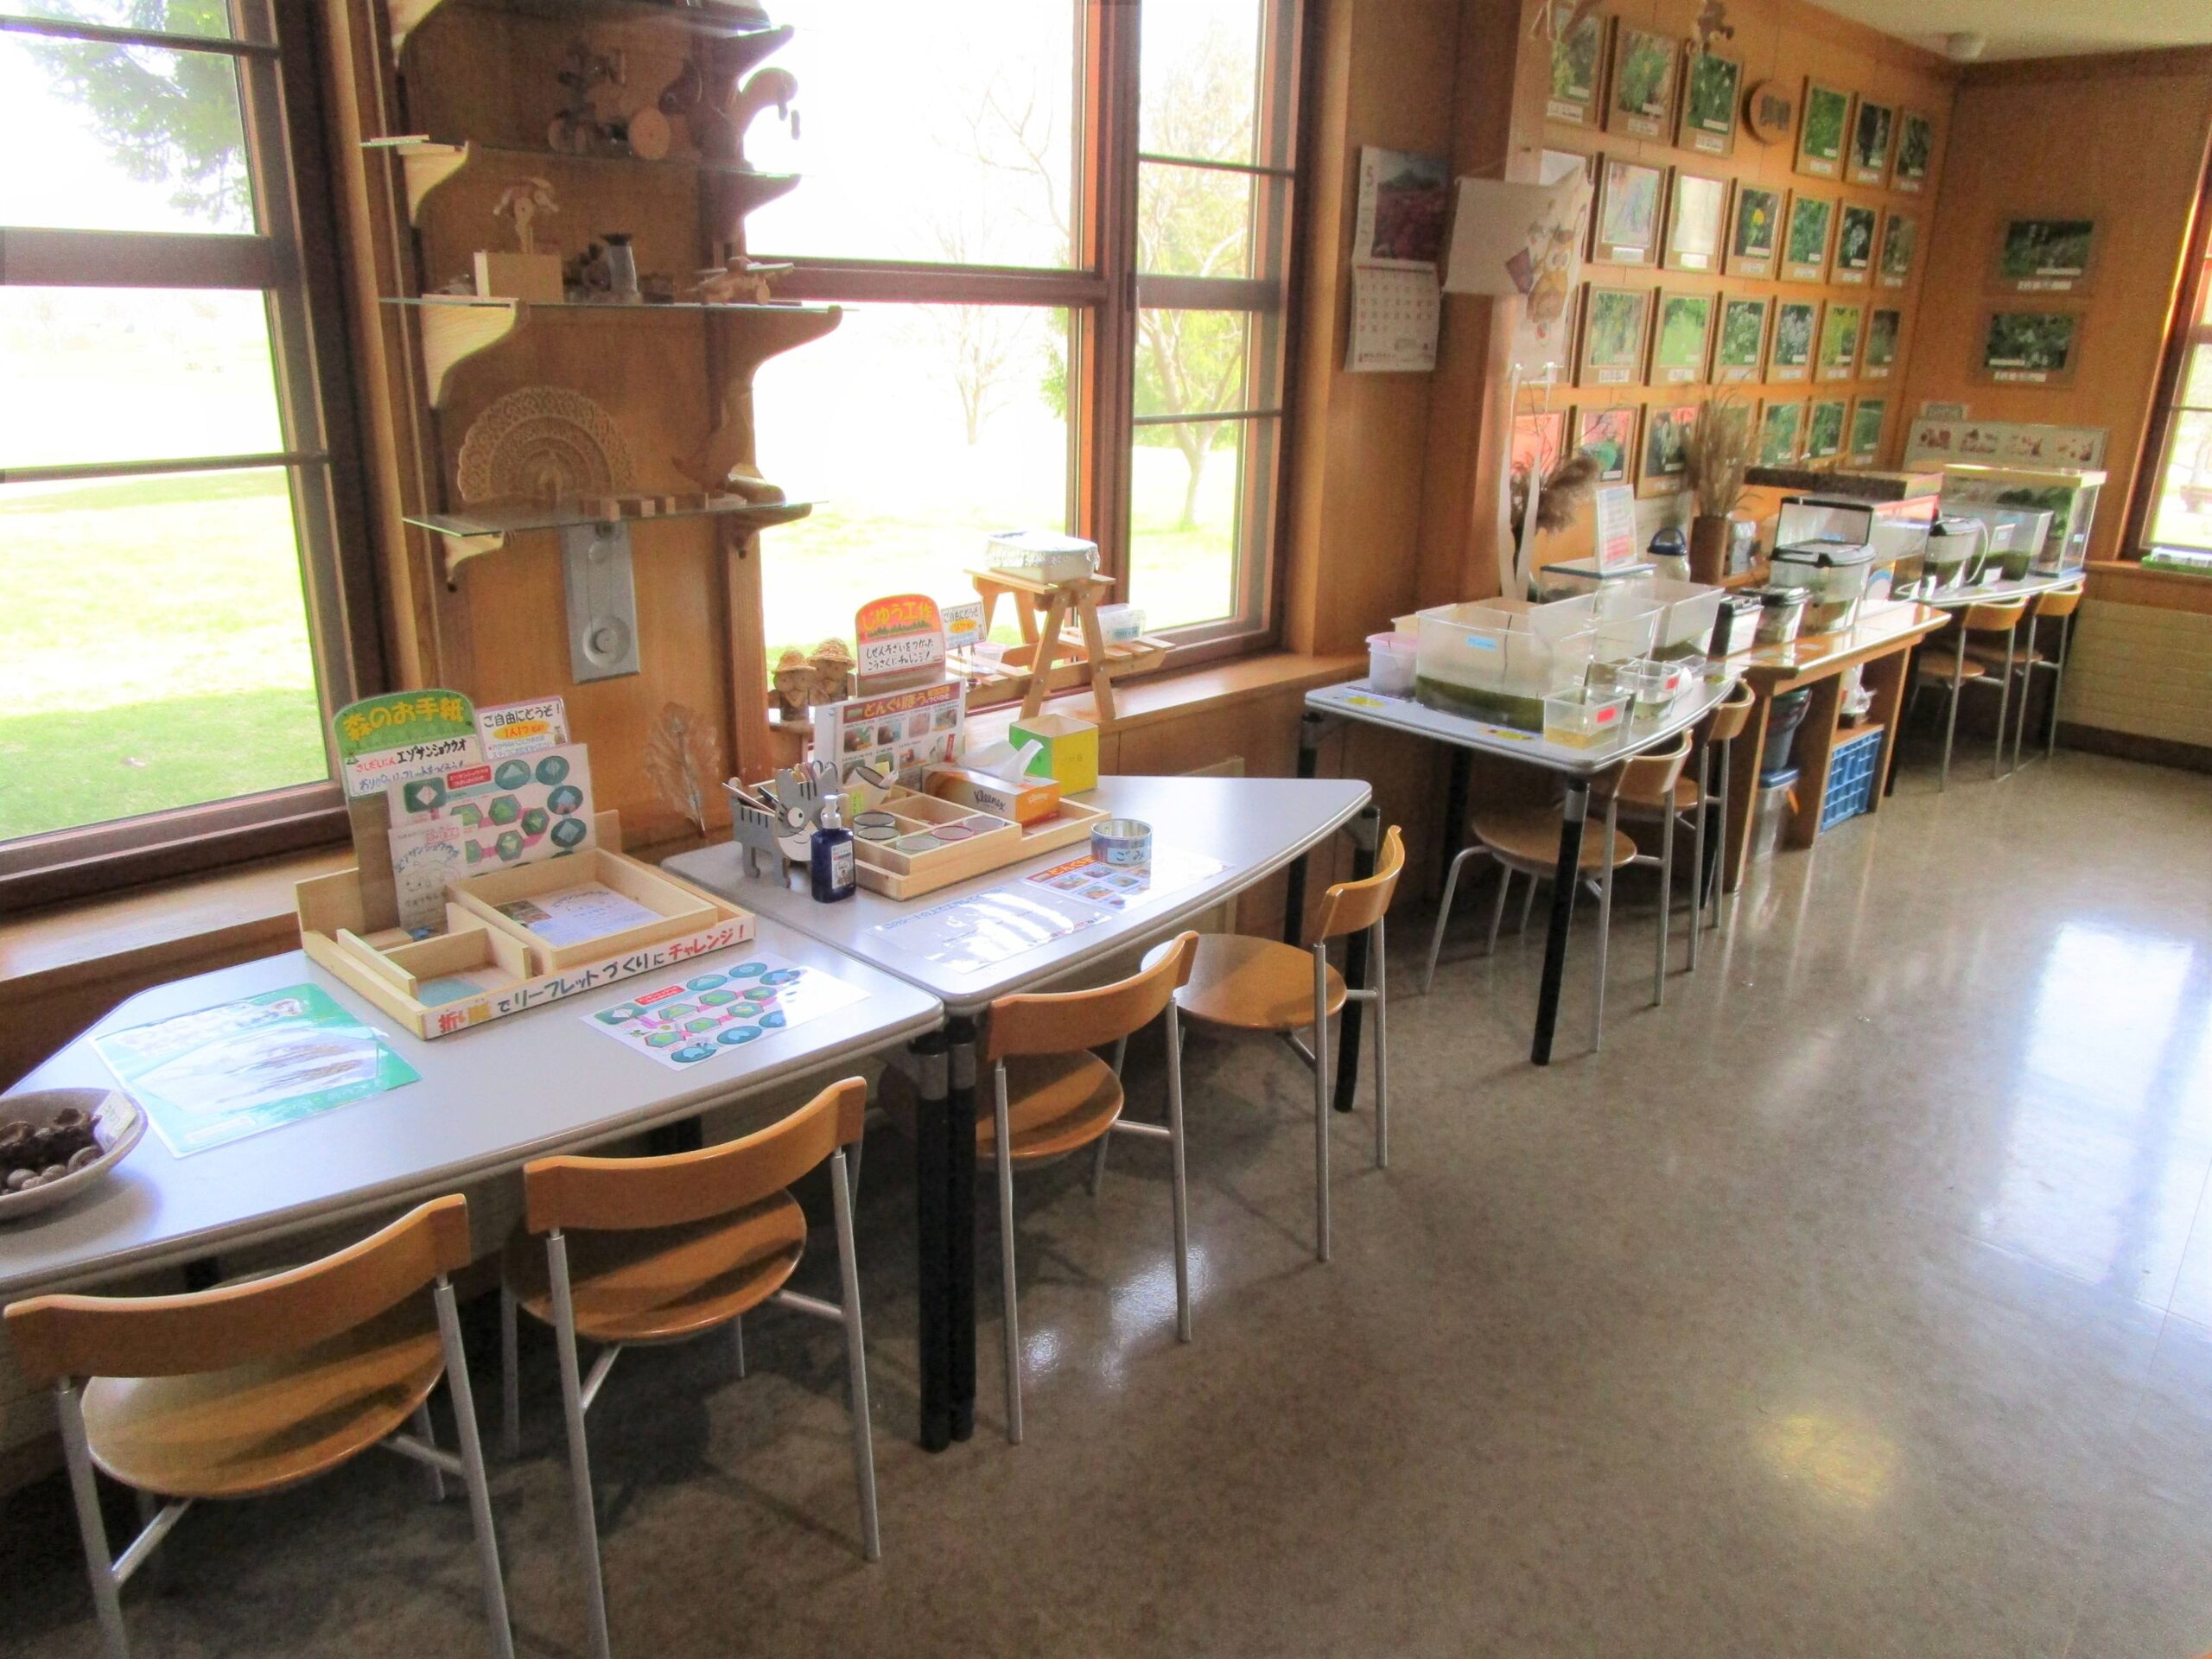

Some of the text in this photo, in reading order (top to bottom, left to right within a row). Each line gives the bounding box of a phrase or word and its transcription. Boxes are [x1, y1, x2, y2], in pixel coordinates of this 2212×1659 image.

[343, 697, 464, 741] 森のお手紙
[397, 738, 467, 764] エゾサンショウウオ
[974, 790, 1007, 812] Kleenex
[1116, 849, 1144, 861] ごみ
